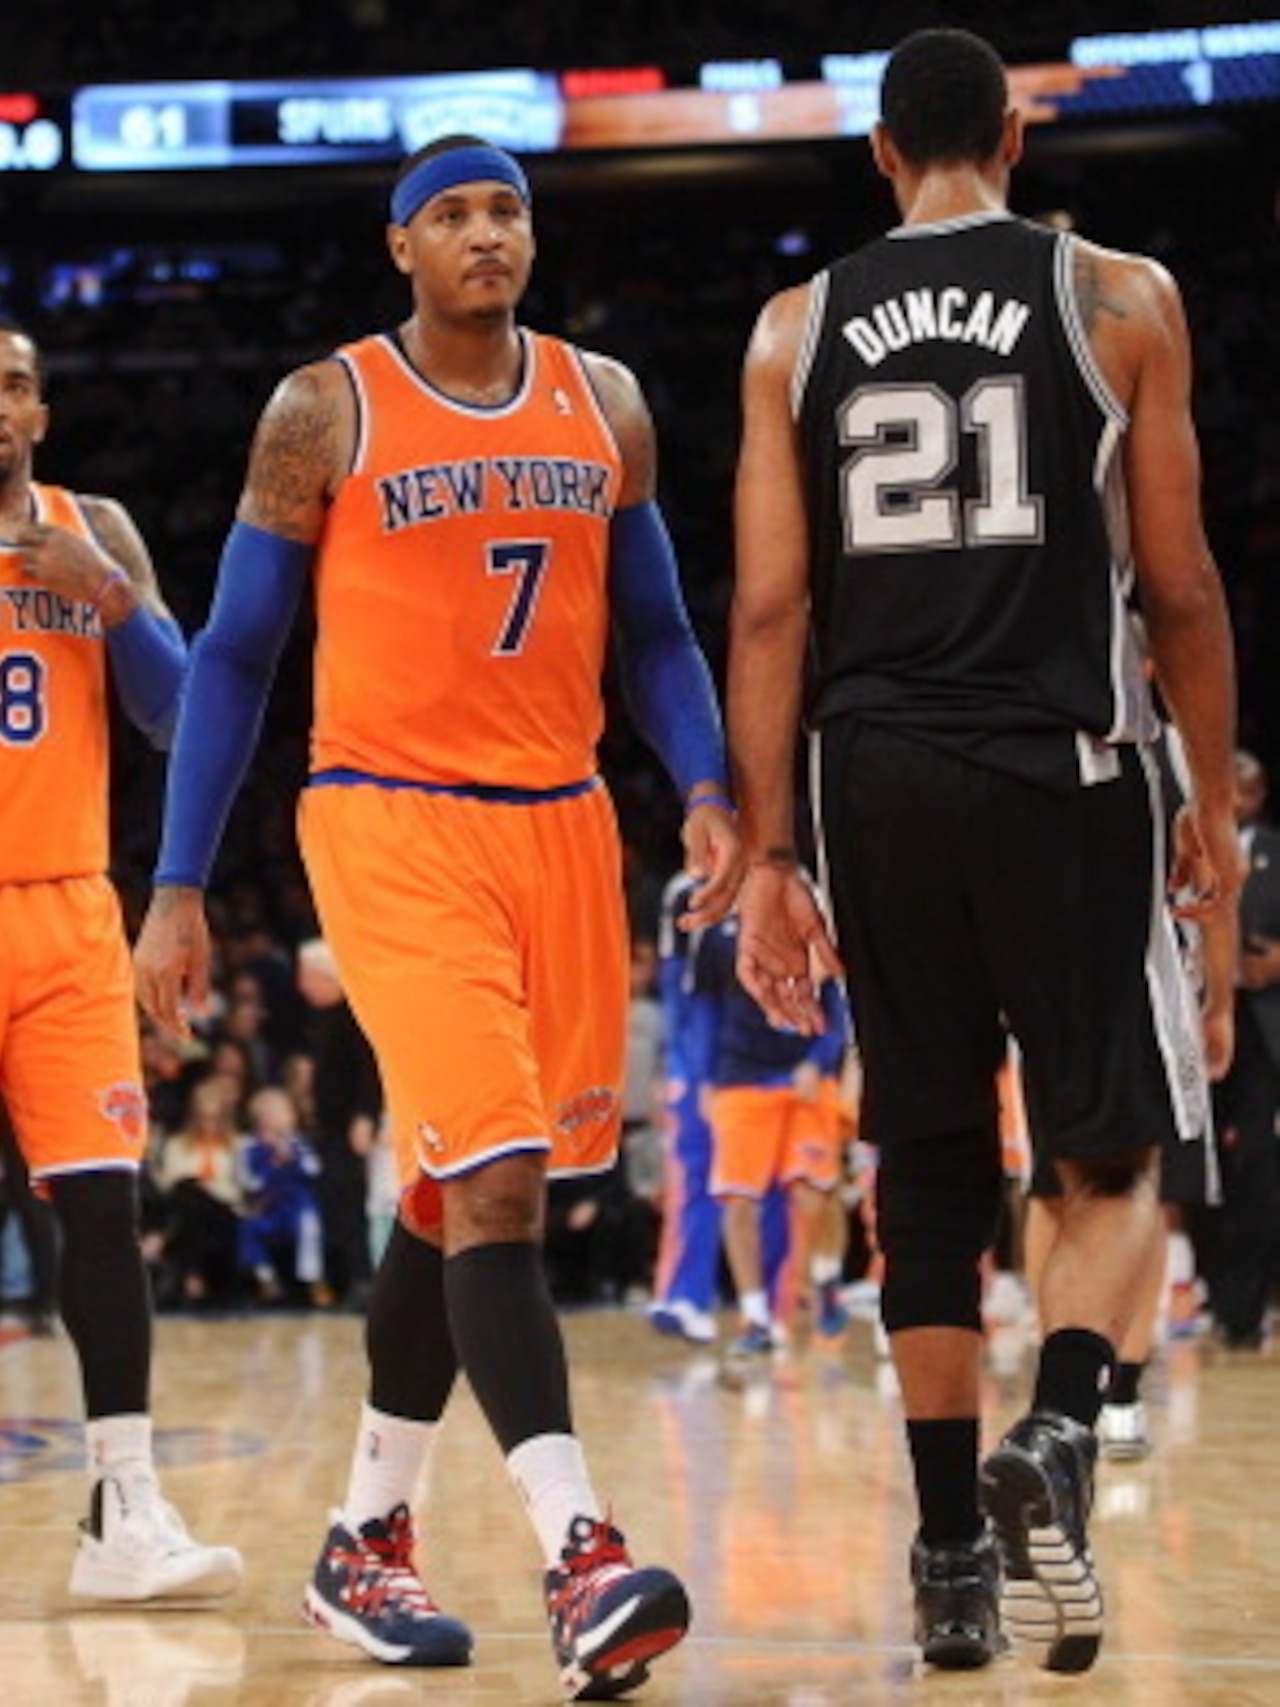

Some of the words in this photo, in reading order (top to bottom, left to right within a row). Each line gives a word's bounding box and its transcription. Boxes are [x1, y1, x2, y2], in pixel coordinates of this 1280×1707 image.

[841, 286, 1031, 368] DUNCAN
[375, 457, 487, 534] NEW
[490, 455, 614, 523] YORK
[835, 374, 1045, 556] 21
[484, 537, 552, 657] 7
